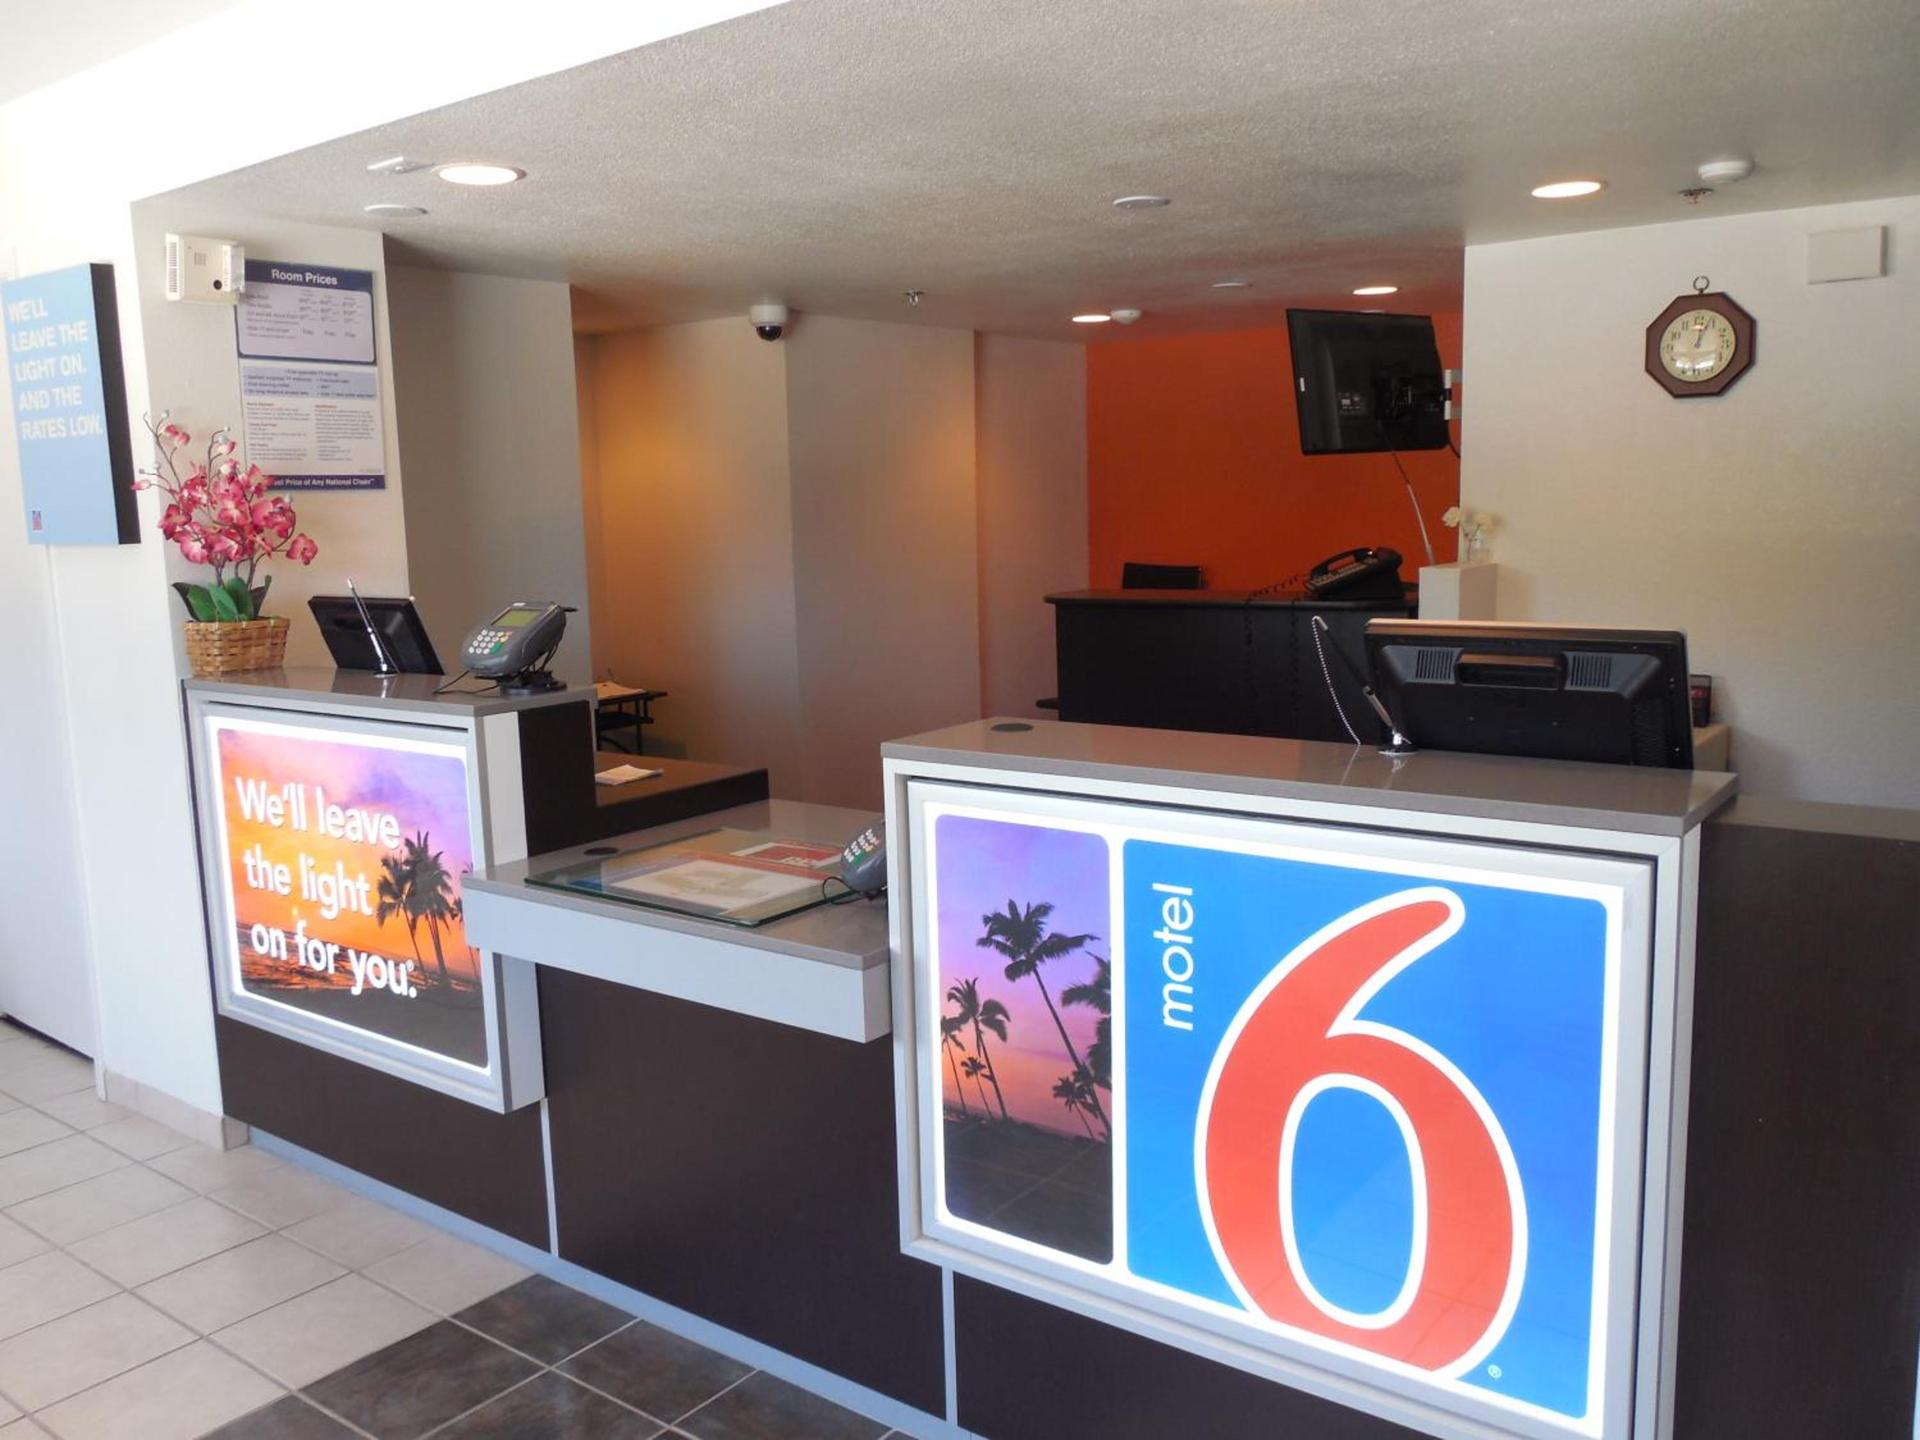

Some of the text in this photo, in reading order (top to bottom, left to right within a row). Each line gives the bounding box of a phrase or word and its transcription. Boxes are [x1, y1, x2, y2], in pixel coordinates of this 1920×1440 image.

[271, 269, 338, 286] Room Prices
[8, 297, 48, 322] WE'LL
[11, 320, 88, 352] LEAVE THE
[14, 353, 87, 382] LIGHT ON.
[19, 385, 82, 411] AND THE
[22, 414, 104, 441] RATES LOW.
[285, 478, 303, 486] Price
[312, 479, 325, 487] Any
[326, 478, 352, 486] National
[235, 776, 401, 849] We'll leave
[243, 844, 374, 920] the light
[251, 923, 288, 961] on
[293, 920, 340, 975] for
[1152, 882, 1194, 1031] motel
[1193, 886, 1529, 1379] 6
